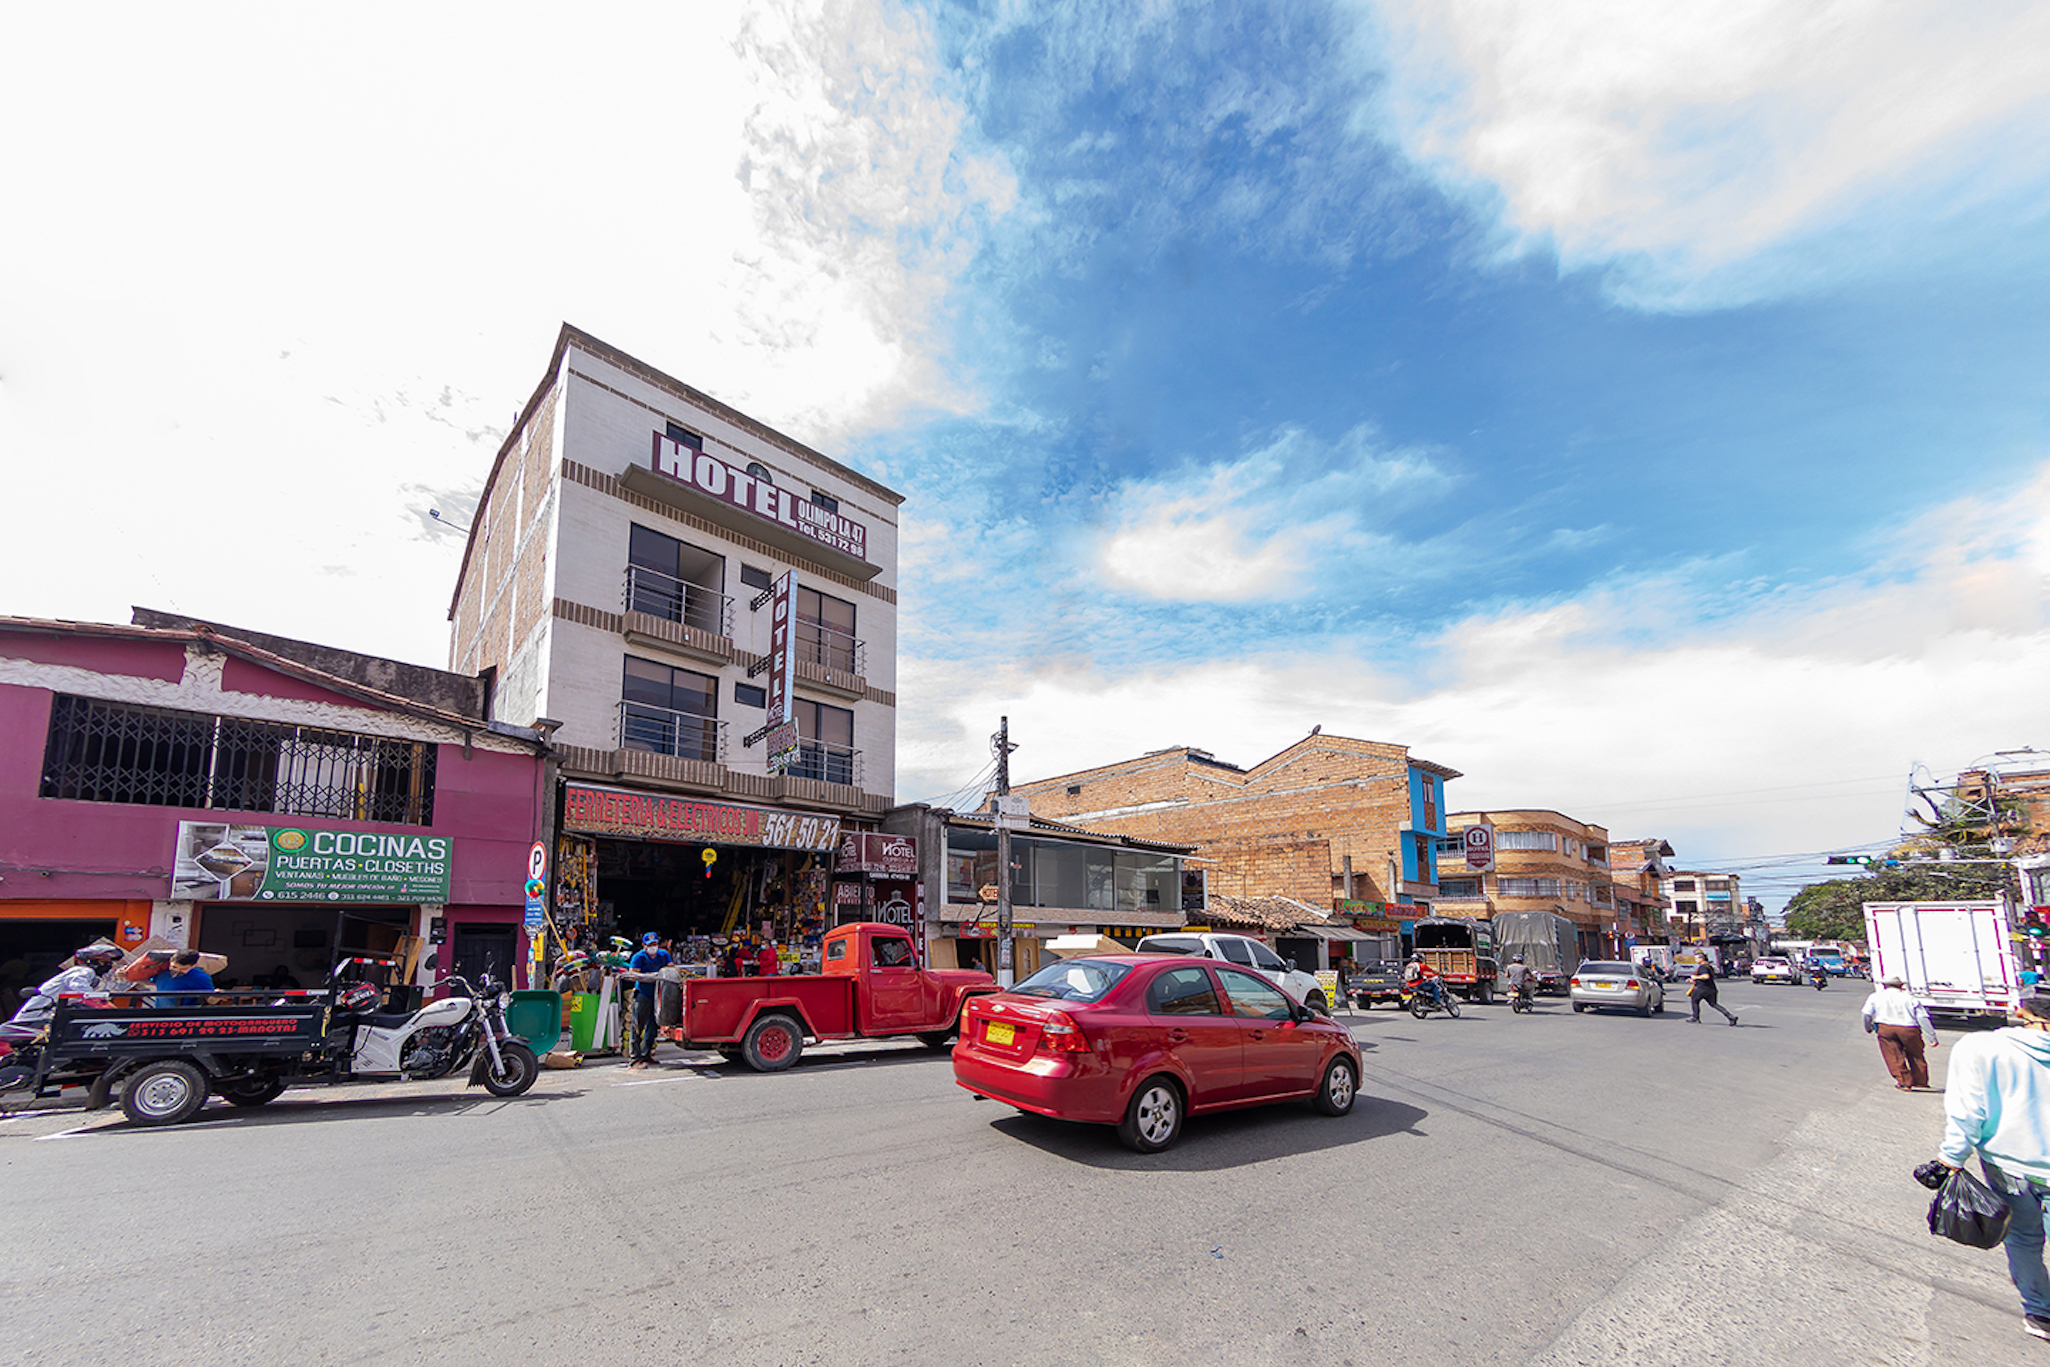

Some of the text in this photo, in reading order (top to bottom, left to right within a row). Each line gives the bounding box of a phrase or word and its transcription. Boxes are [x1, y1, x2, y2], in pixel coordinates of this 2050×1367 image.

[660, 436, 797, 528] HOTEL
[798, 500, 864, 543] OLIMPO LA 47
[798, 520, 864, 557] Tel. 531 72 98
[772, 573, 788, 698] HOTEL
[566, 788, 653, 827] FERRETERIA
[656, 801, 667, 826] &
[669, 802, 742, 835] ELECTRICOS
[743, 809, 760, 836] JM
[763, 813, 796, 847] 561
[796, 817, 819, 850] 50
[817, 819, 840, 851] 21
[314, 832, 446, 860] COCINAS
[882, 841, 915, 859] HOTEL
[276, 857, 445, 875] PUERTAS CLOSETHS
[533, 850, 542, 875] P
[275, 870, 325, 880] VENTANAS
[331, 872, 371, 881] MUEBLES
[383, 873, 403, 882] BAÑO
[408, 875, 443, 884] MESONES
[284, 881, 315, 889] SOMOS
[328, 882, 358, 890] MEJOR
[277, 891, 326, 900] 615 2446
[878, 900, 914, 924] HOTEL
[130, 1021, 182, 1030] SERVICIO
